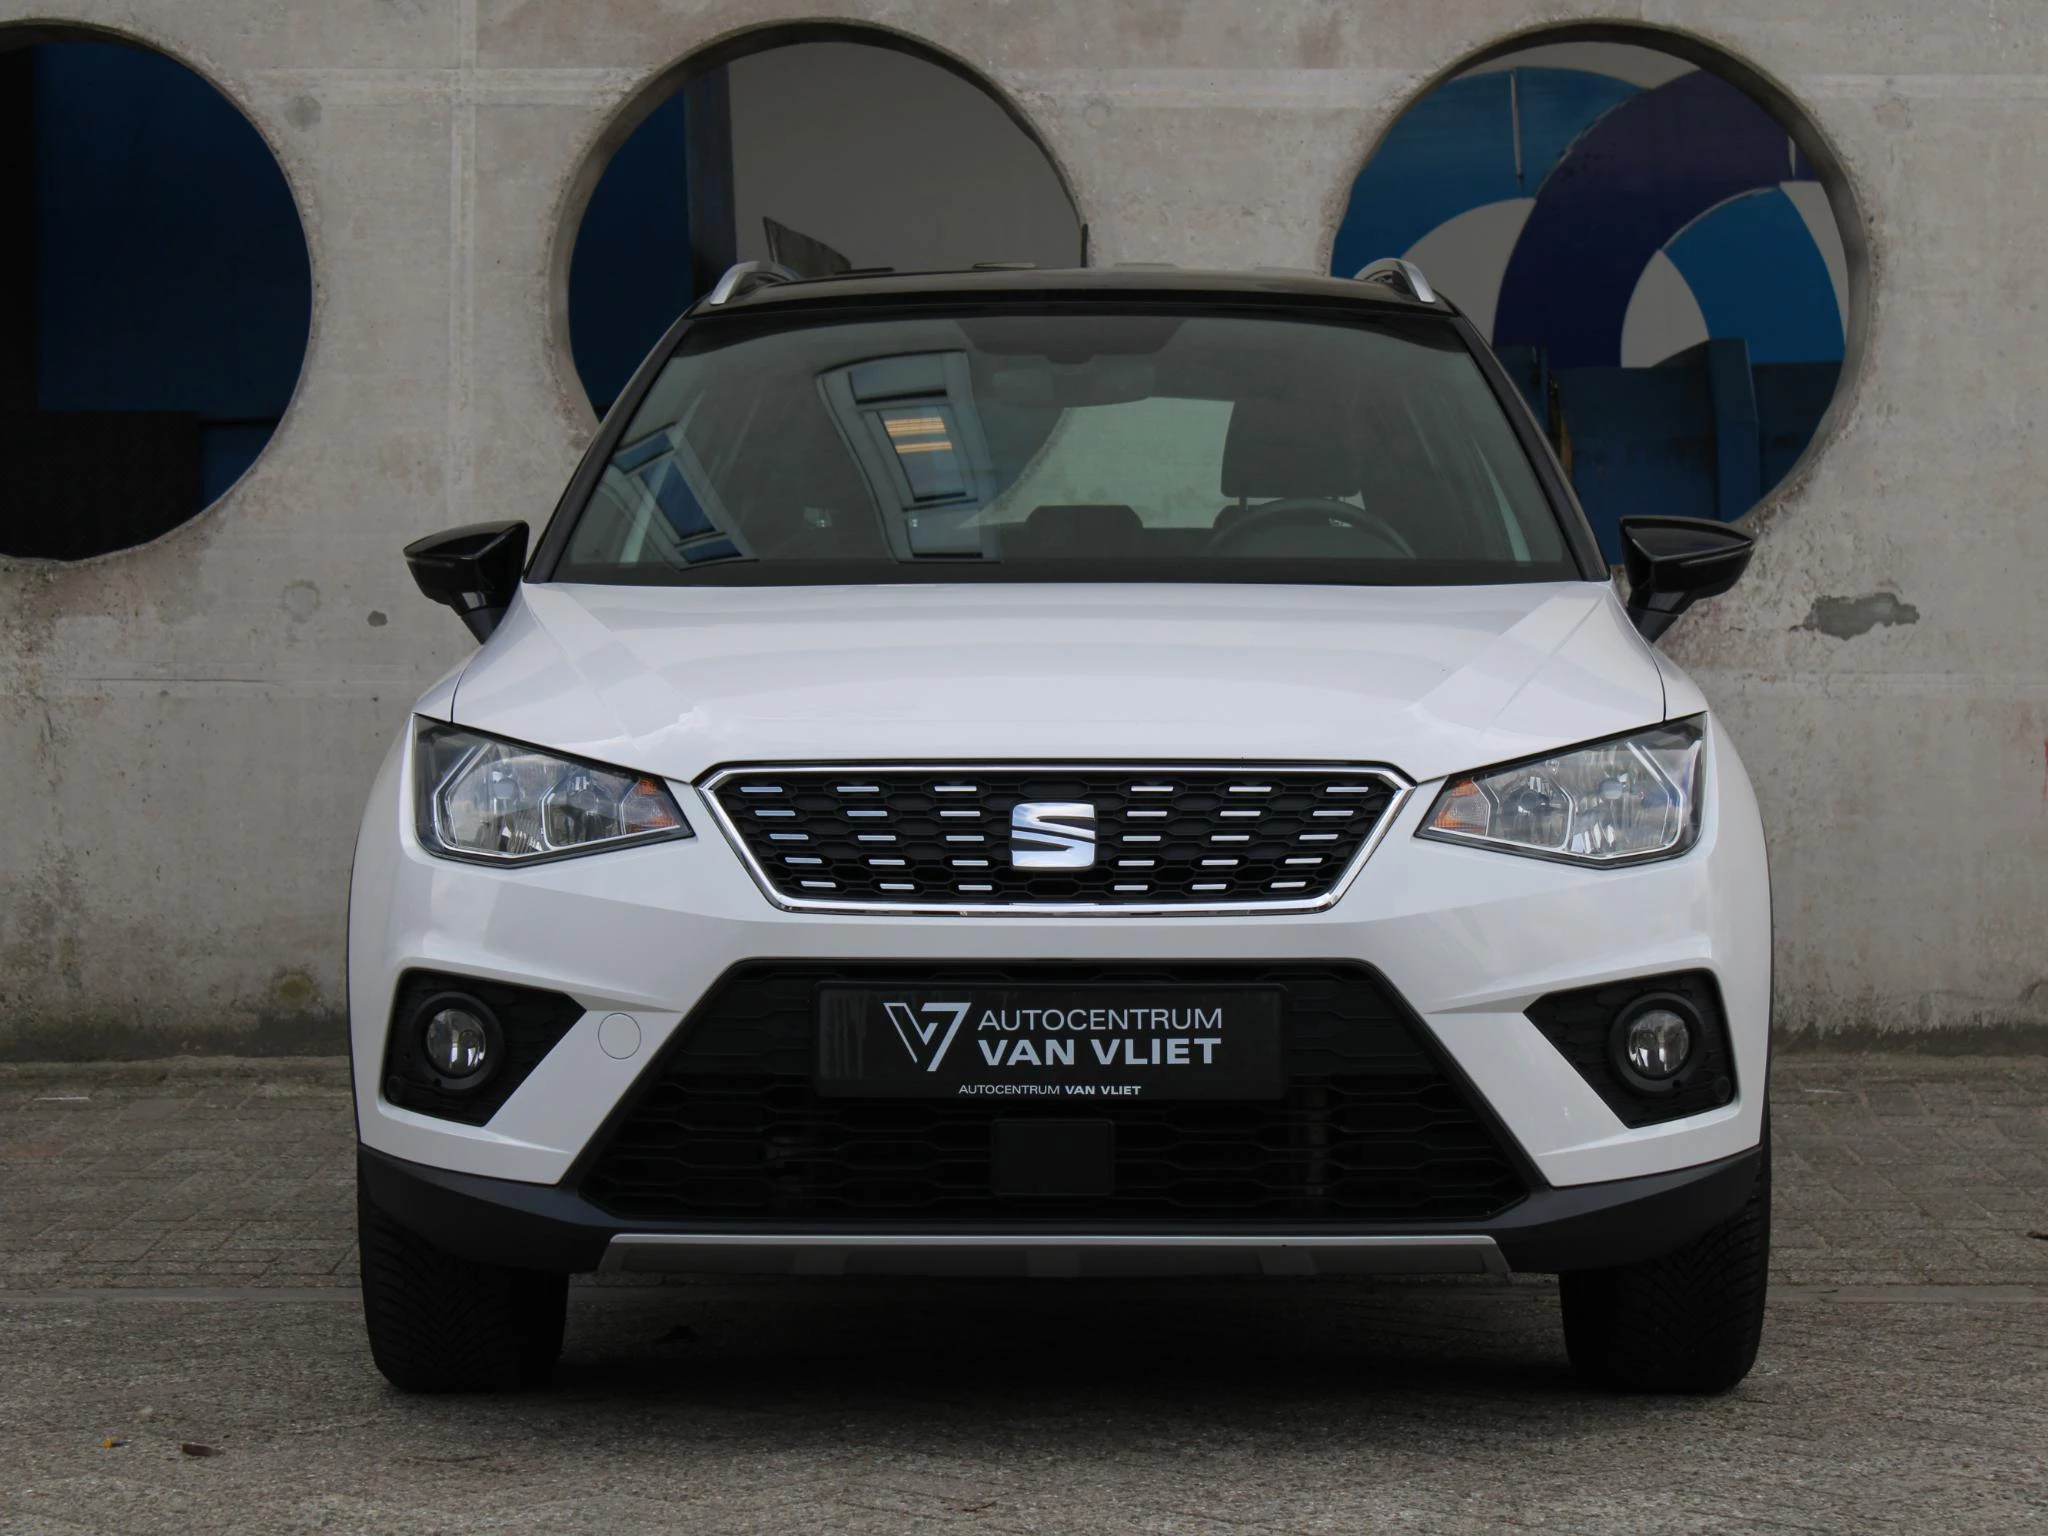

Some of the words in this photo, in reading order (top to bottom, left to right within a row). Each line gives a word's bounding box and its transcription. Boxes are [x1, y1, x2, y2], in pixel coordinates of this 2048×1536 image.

[977, 1008, 1222, 1031] AUTOCENTRUM
[977, 1038, 1075, 1066] VAN
[1090, 1037, 1222, 1065] VLIET
[958, 1084, 1060, 1096] AUTOCENTRUM
[1065, 1085, 1096, 1096] VAN
[1100, 1085, 1142, 1096] VLIET
